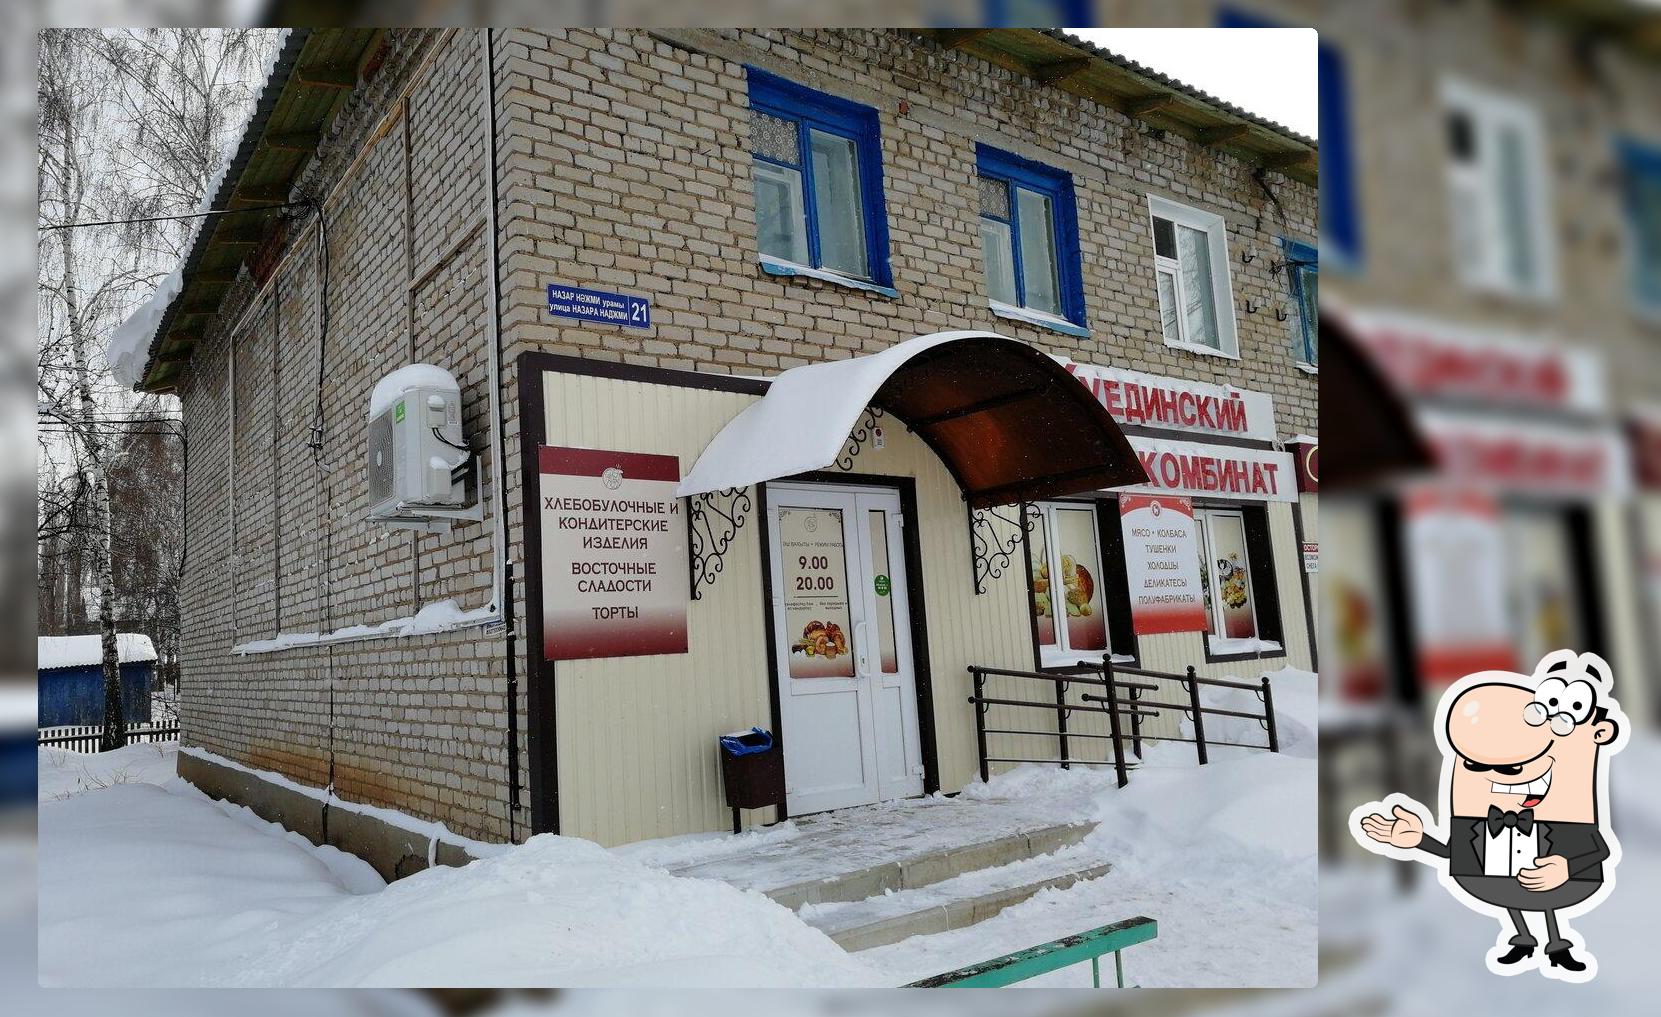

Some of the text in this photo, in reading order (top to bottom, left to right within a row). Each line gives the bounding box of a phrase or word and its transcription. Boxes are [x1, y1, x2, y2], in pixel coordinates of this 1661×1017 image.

[552, 289, 625, 310] НАЗАР НӘЖМИ урамы
[549, 303, 628, 321] улица НАЗАРА НАДЖМИ
[631, 302, 647, 323] 21
[1064, 363, 1248, 433] УЕДИНСКИЙ
[544, 496, 679, 514] ХЛЕБОБУЛОЧНЫЕ И
[558, 517, 668, 532] КОНДИТЕРСКИЕ
[1131, 528, 1187, 539] МЯСО КОЛБАСА
[583, 536, 648, 550] ИЗДЕЛИЯ
[1144, 544, 1177, 554] ТУШЕНКИ
[571, 562, 657, 575] ВОСТОЧНЫЕ
[798, 555, 828, 570] 9.00
[1147, 561, 1179, 571] ХОЛОДЦЫ
[577, 579, 652, 593] СЛАДОСТИ
[796, 576, 834, 591] 20.00
[1143, 578, 1188, 589] ДЕЛИКАТЕСЫ
[1138, 594, 1196, 605] ПОЛУФАБРИКАТЫ
[592, 605, 639, 619] ТОРТЫ
